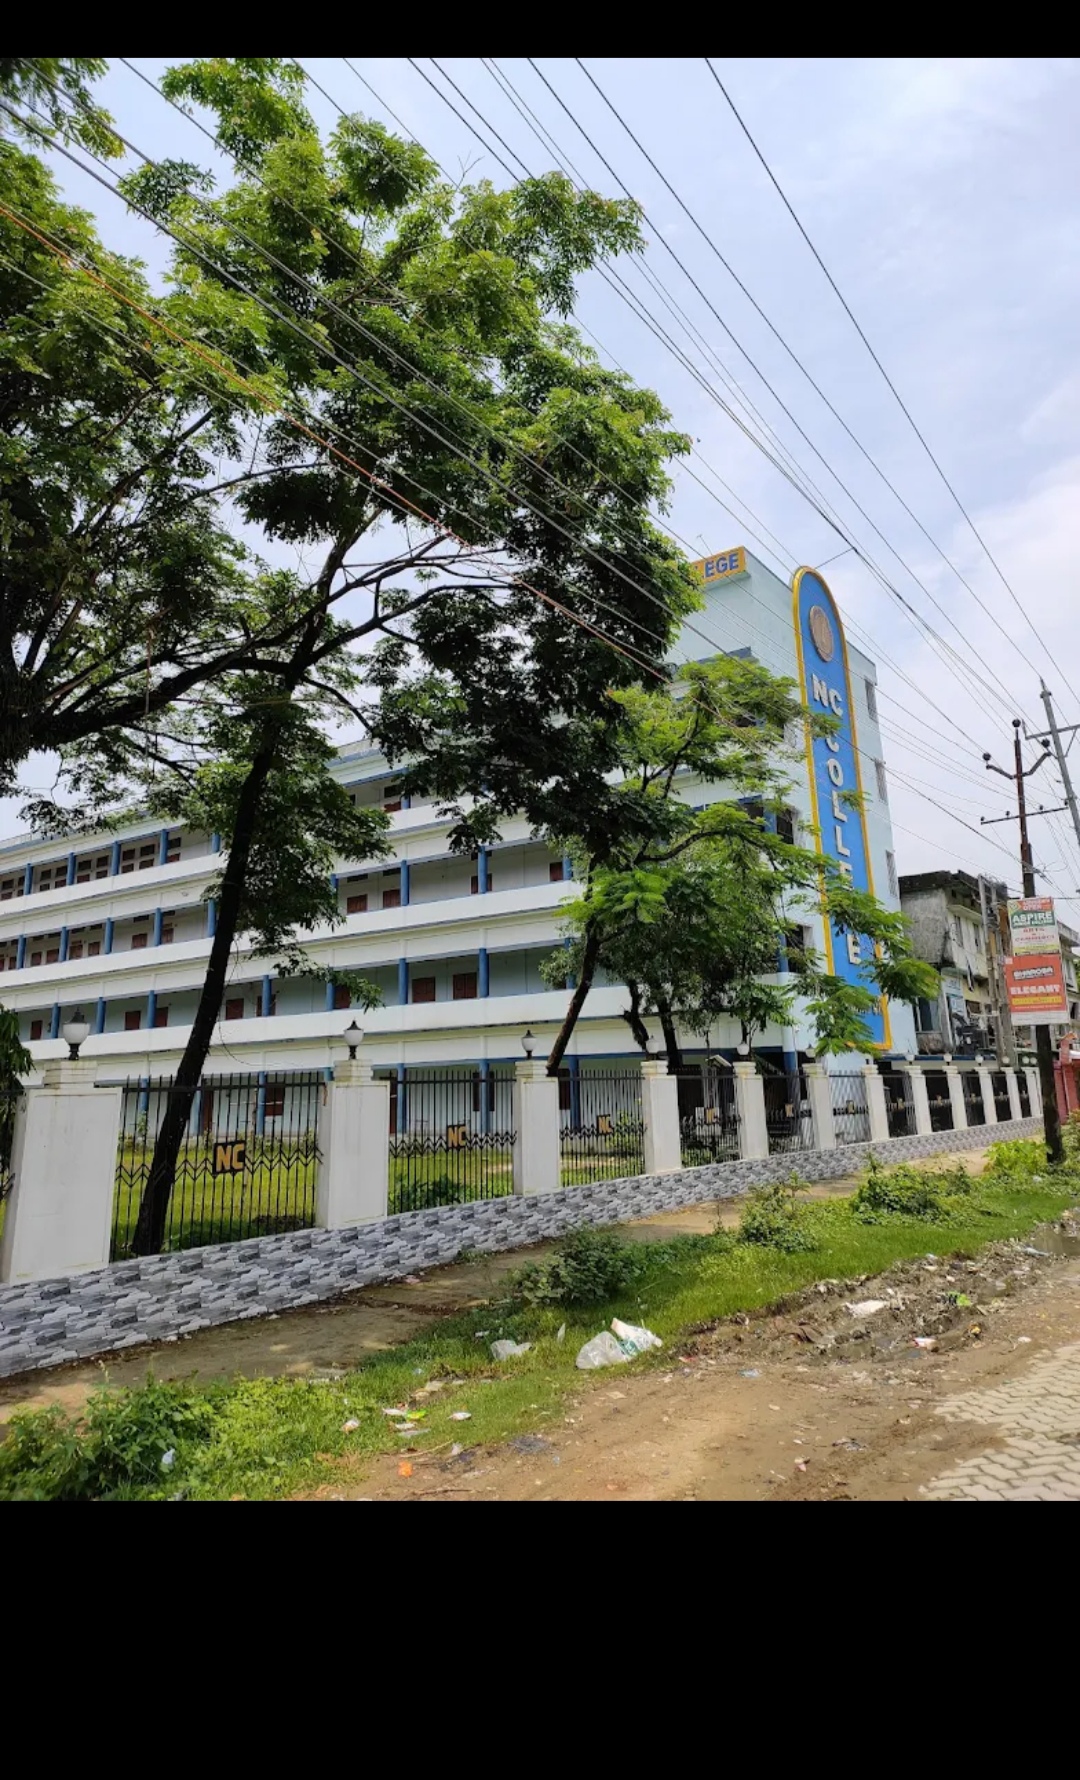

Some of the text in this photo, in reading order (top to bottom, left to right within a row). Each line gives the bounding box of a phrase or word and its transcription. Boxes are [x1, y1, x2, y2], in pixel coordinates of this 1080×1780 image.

[704, 553, 739, 578] EGE
[811, 673, 843, 717] NC
[826, 730, 861, 965] COLLEE
[1012, 911, 1053, 924] ASPIRE
[1010, 984, 1060, 995] ELEGANT
[447, 1126, 467, 1147] NC
[216, 1143, 245, 1172] NC
